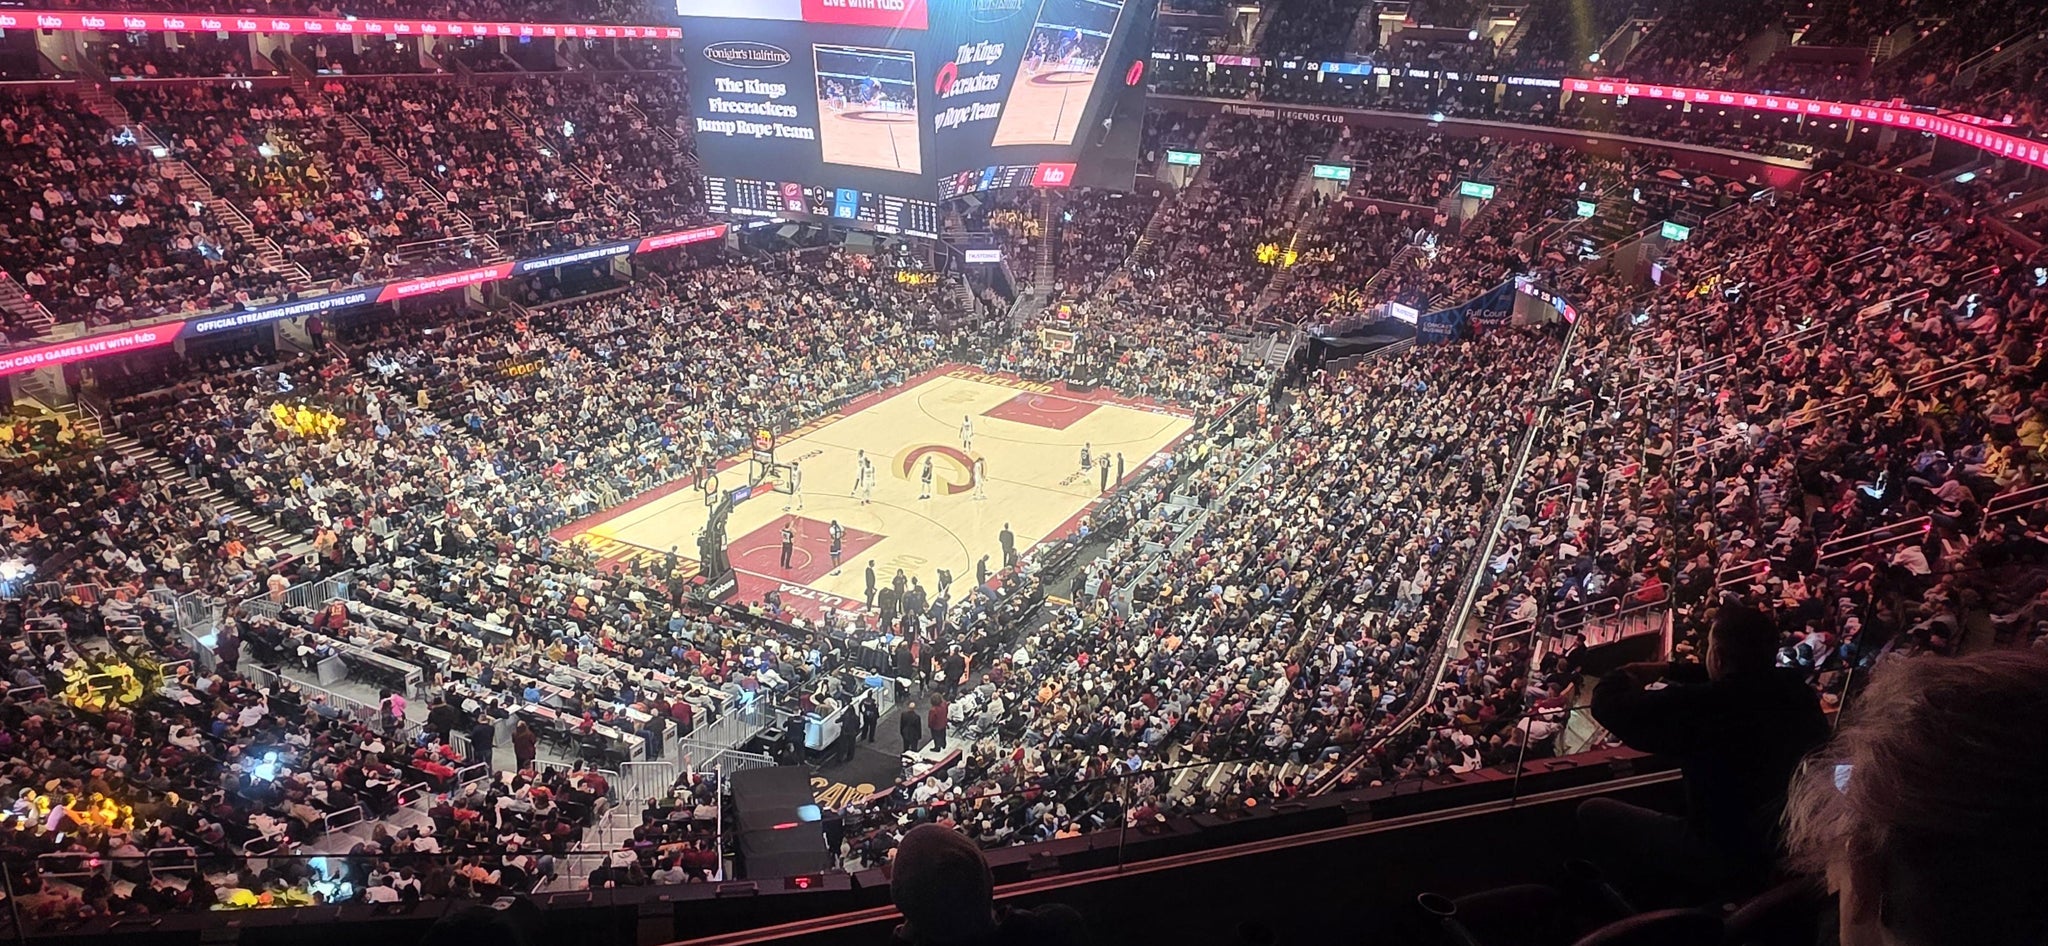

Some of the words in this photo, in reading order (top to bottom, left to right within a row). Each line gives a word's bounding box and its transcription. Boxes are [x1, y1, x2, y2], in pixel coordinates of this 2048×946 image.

[38, 16, 61, 26] fubo
[82, 17, 104, 27] fubo
[124, 18, 145, 28] fubo
[164, 18, 184, 29] fubo
[202, 19, 221, 29] fubo
[238, 20, 256, 30] fubo
[272, 21, 290, 30] fubo
[305, 22, 321, 31] fubo
[336, 22, 352, 31] fubo
[366, 23, 381, 31] fubo
[394, 24, 409, 32] fubo
[422, 24, 436, 32] fubo
[448, 24, 462, 33] fubo
[707, 48, 748, 60] Tonight's
[749, 50, 790, 62] Halftime
[956, 43, 975, 66] The
[973, 40, 1004, 65] Kings
[716, 78, 743, 92] The
[745, 80, 786, 97] Kings
[709, 98, 798, 118] Firecrackers
[968, 102, 1001, 121] Team
[1232, 105, 1274, 118] Huntington
[1283, 111, 1320, 121] LEGENDS
[1322, 114, 1344, 124] CLUB
[697, 118, 736, 136] Jump
[736, 120, 772, 138] Rope
[774, 123, 815, 140] Team
[1042, 168, 1064, 182] fubo
[789, 200, 802, 211] 52
[523, 259, 549, 272] OFFICIAL
[549, 254, 578, 267] STREAMING
[578, 251, 600, 262] PARTNER
[606, 248, 617, 256] THE
[617, 245, 630, 254] CAVS
[398, 284, 419, 294] WATCH
[420, 280, 436, 290] CAVS
[437, 278, 456, 286] GAMES
[456, 275, 469, 284] LIVE
[470, 272, 484, 280] WITH
[484, 270, 498, 278] fubo
[196, 316, 237, 332] OFFICIAL
[237, 308, 285, 324] STREAMING
[285, 302, 320, 317] PARTNER
[320, 300, 330, 310] OF
[330, 297, 346, 308] THE
[345, 293, 366, 305] CAVS
[1483, 310, 1507, 318] Court
[1423, 327, 1452, 335] BUSINESS
[1424, 321, 1453, 329] COMCAST
[15, 353, 44, 367] CAVS
[45, 346, 84, 362] GAMES
[84, 342, 106, 353] LIVE
[107, 338, 133, 350] WITH
[134, 332, 156, 344] fubo
[947, 371, 1054, 394] CLEVELAND
[779, 583, 842, 606] ULTRA
